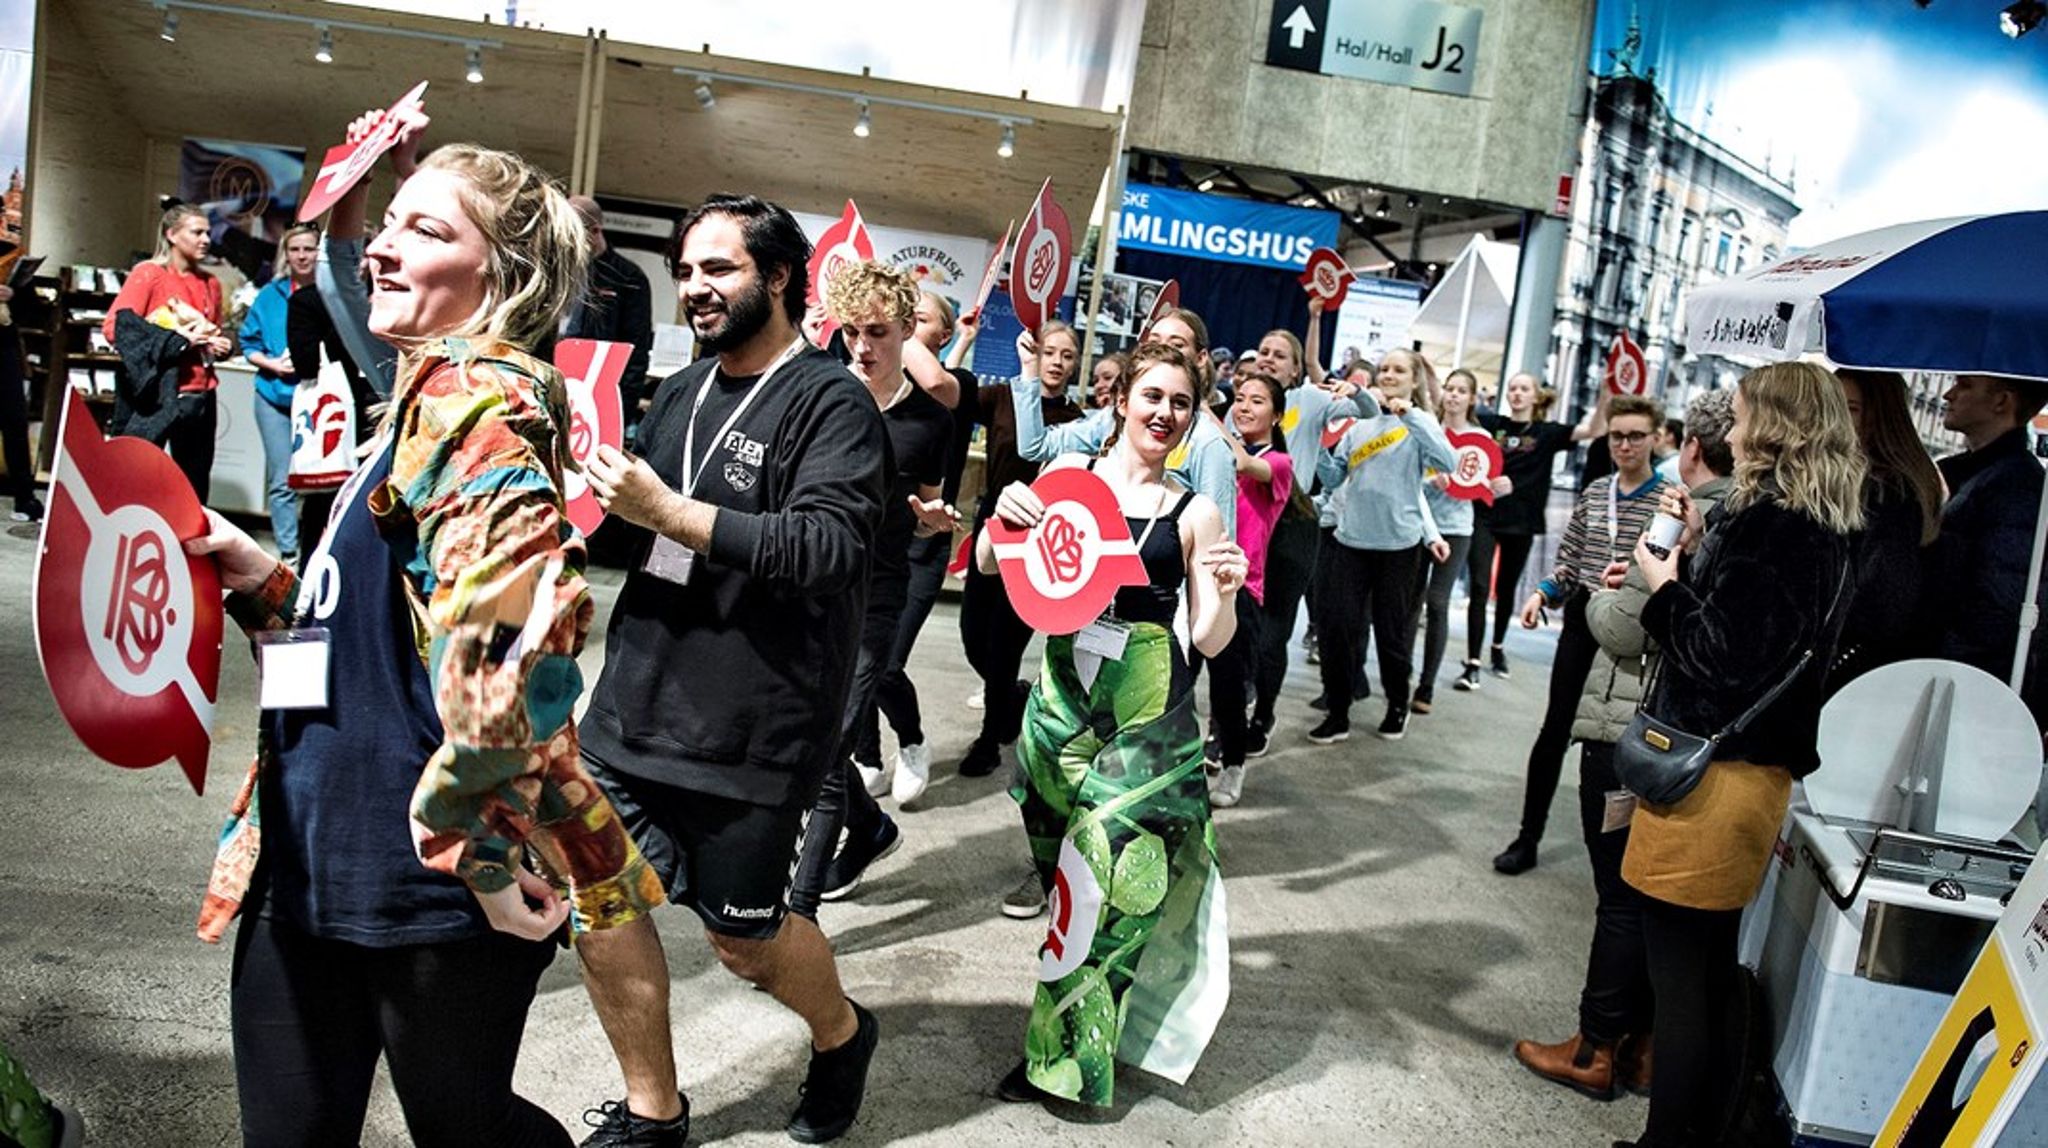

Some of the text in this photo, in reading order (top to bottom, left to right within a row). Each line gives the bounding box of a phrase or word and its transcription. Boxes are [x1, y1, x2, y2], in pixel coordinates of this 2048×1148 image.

[1336, 26, 1465, 73] Hal/Hall J2
[1117, 212, 1314, 265] MLINGSHUS
